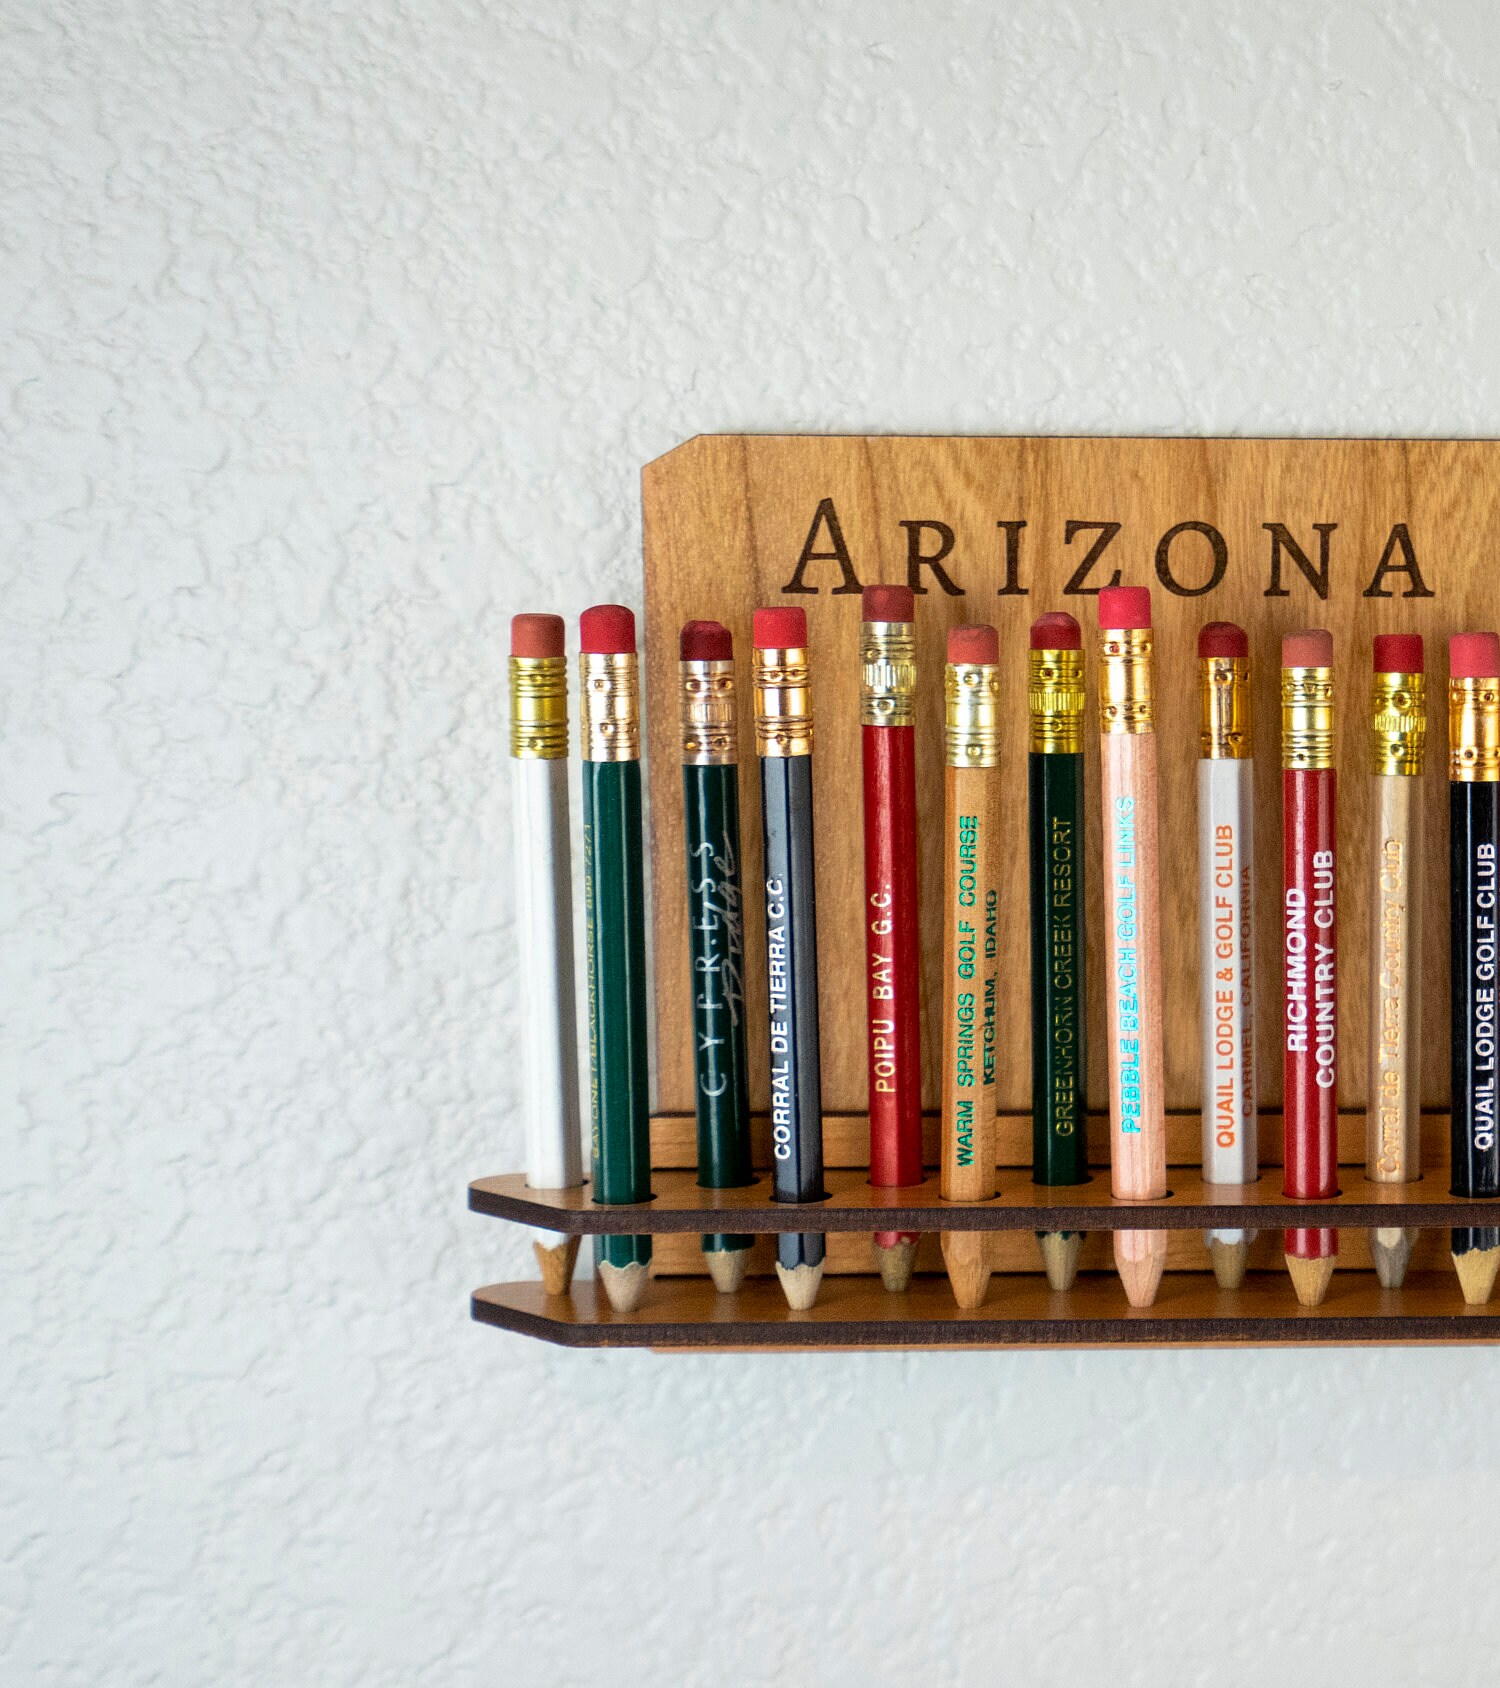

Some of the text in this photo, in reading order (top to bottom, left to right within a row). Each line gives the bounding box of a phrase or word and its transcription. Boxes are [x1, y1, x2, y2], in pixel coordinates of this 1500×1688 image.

[687, 841, 727, 1097] CYPRESS
[768, 925, 786, 1015] TIERRA
[771, 1022, 788, 1053] DE
[872, 884, 896, 1093] POIPU BAY G.C.
[957, 815, 978, 1167] WARM SPRINGS GOLF COURSE
[985, 890, 997, 958] IDAHO
[1052, 815, 1074, 1136] GREENHORN CREEK RESORT
[1116, 797, 1140, 1133] PEBBLE BEACH GOLF LINKS
[1215, 825, 1235, 1148] QUAIL LODGE & GOLF CLUB
[1241, 866, 1252, 1007] CALIFORNIA
[1286, 888, 1308, 1052] RICHMOND
[1314, 850, 1335, 1088] COUNTRY CLUB
[1377, 839, 1404, 1173] Corral de Tierra Country Club
[1475, 844, 1495, 1150] QUAIL LODGE GOLF CLUB
[772, 1061, 791, 1160] CORRAL
